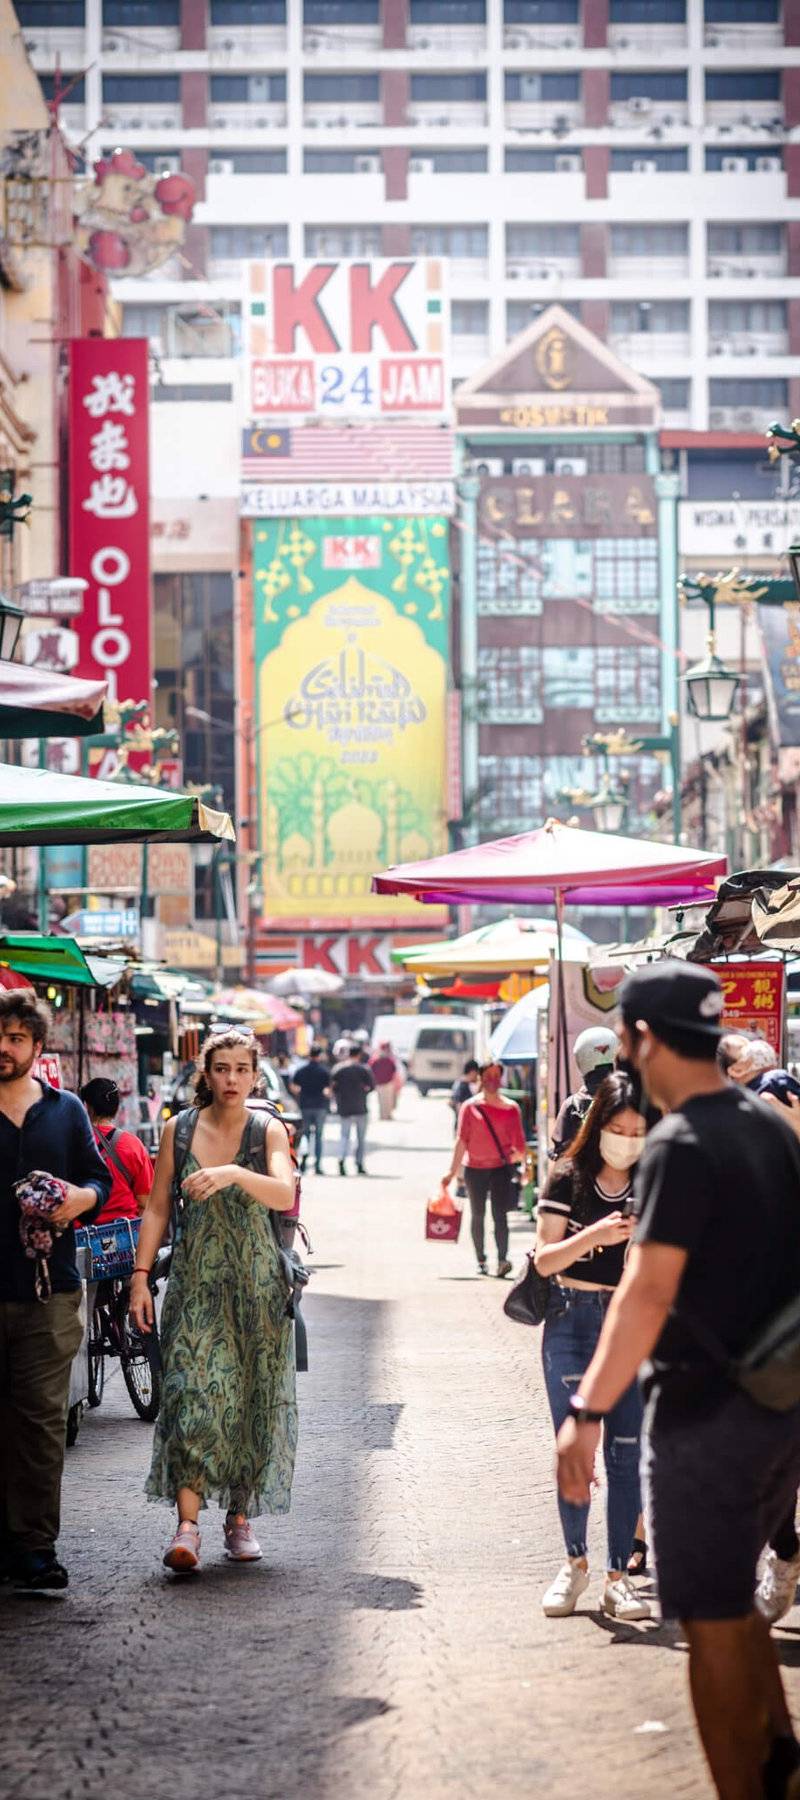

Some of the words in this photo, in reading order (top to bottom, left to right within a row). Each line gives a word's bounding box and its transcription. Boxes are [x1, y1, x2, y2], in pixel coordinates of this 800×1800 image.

[273, 262, 419, 354] KK
[252, 366, 314, 406] BUKA
[320, 366, 373, 405] 24
[382, 365, 441, 404] JAM
[241, 488, 346, 510] KELUARGA
[352, 488, 452, 509] MALAYSIA
[331, 539, 370, 555] KK
[302, 938, 386, 975] KK
